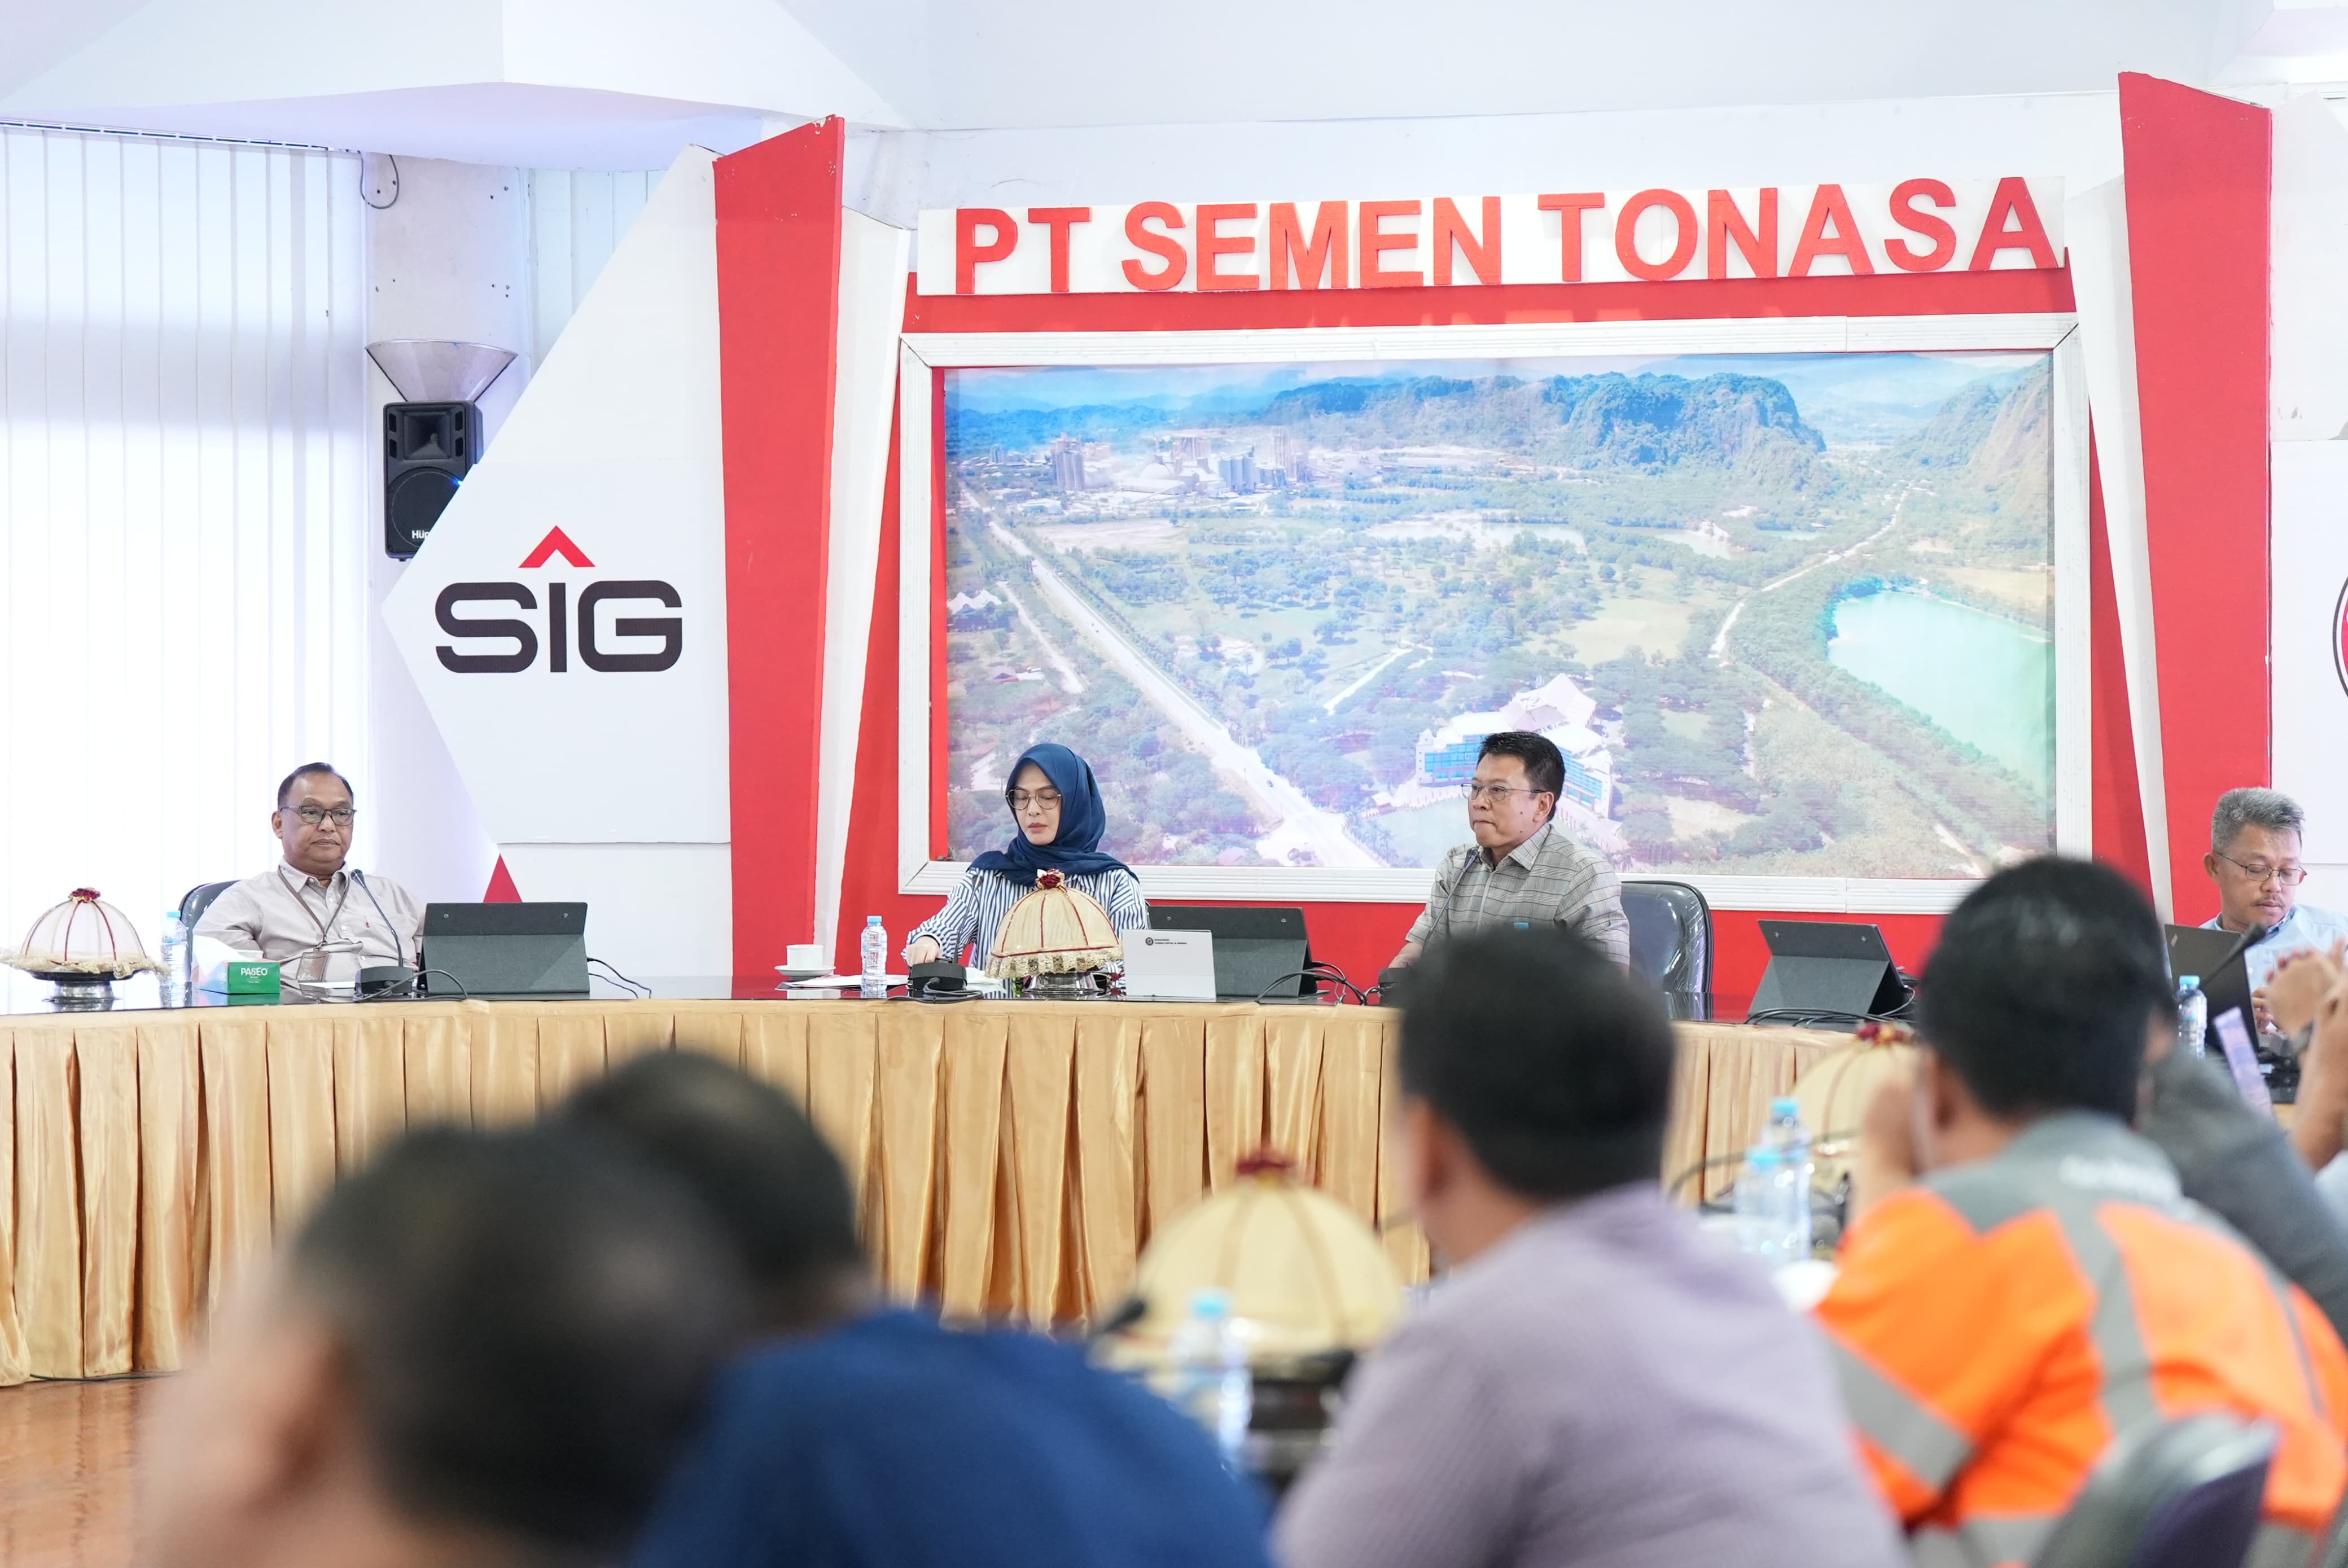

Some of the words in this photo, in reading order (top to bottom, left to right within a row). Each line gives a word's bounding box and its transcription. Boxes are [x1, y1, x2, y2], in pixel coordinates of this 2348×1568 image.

[955, 207, 1091, 295] PT
[1122, 194, 1501, 293] SEMEN
[1539, 176, 2059, 283] TONASA
[435, 580, 682, 673] SIG
[240, 967, 268, 976] PASEO
